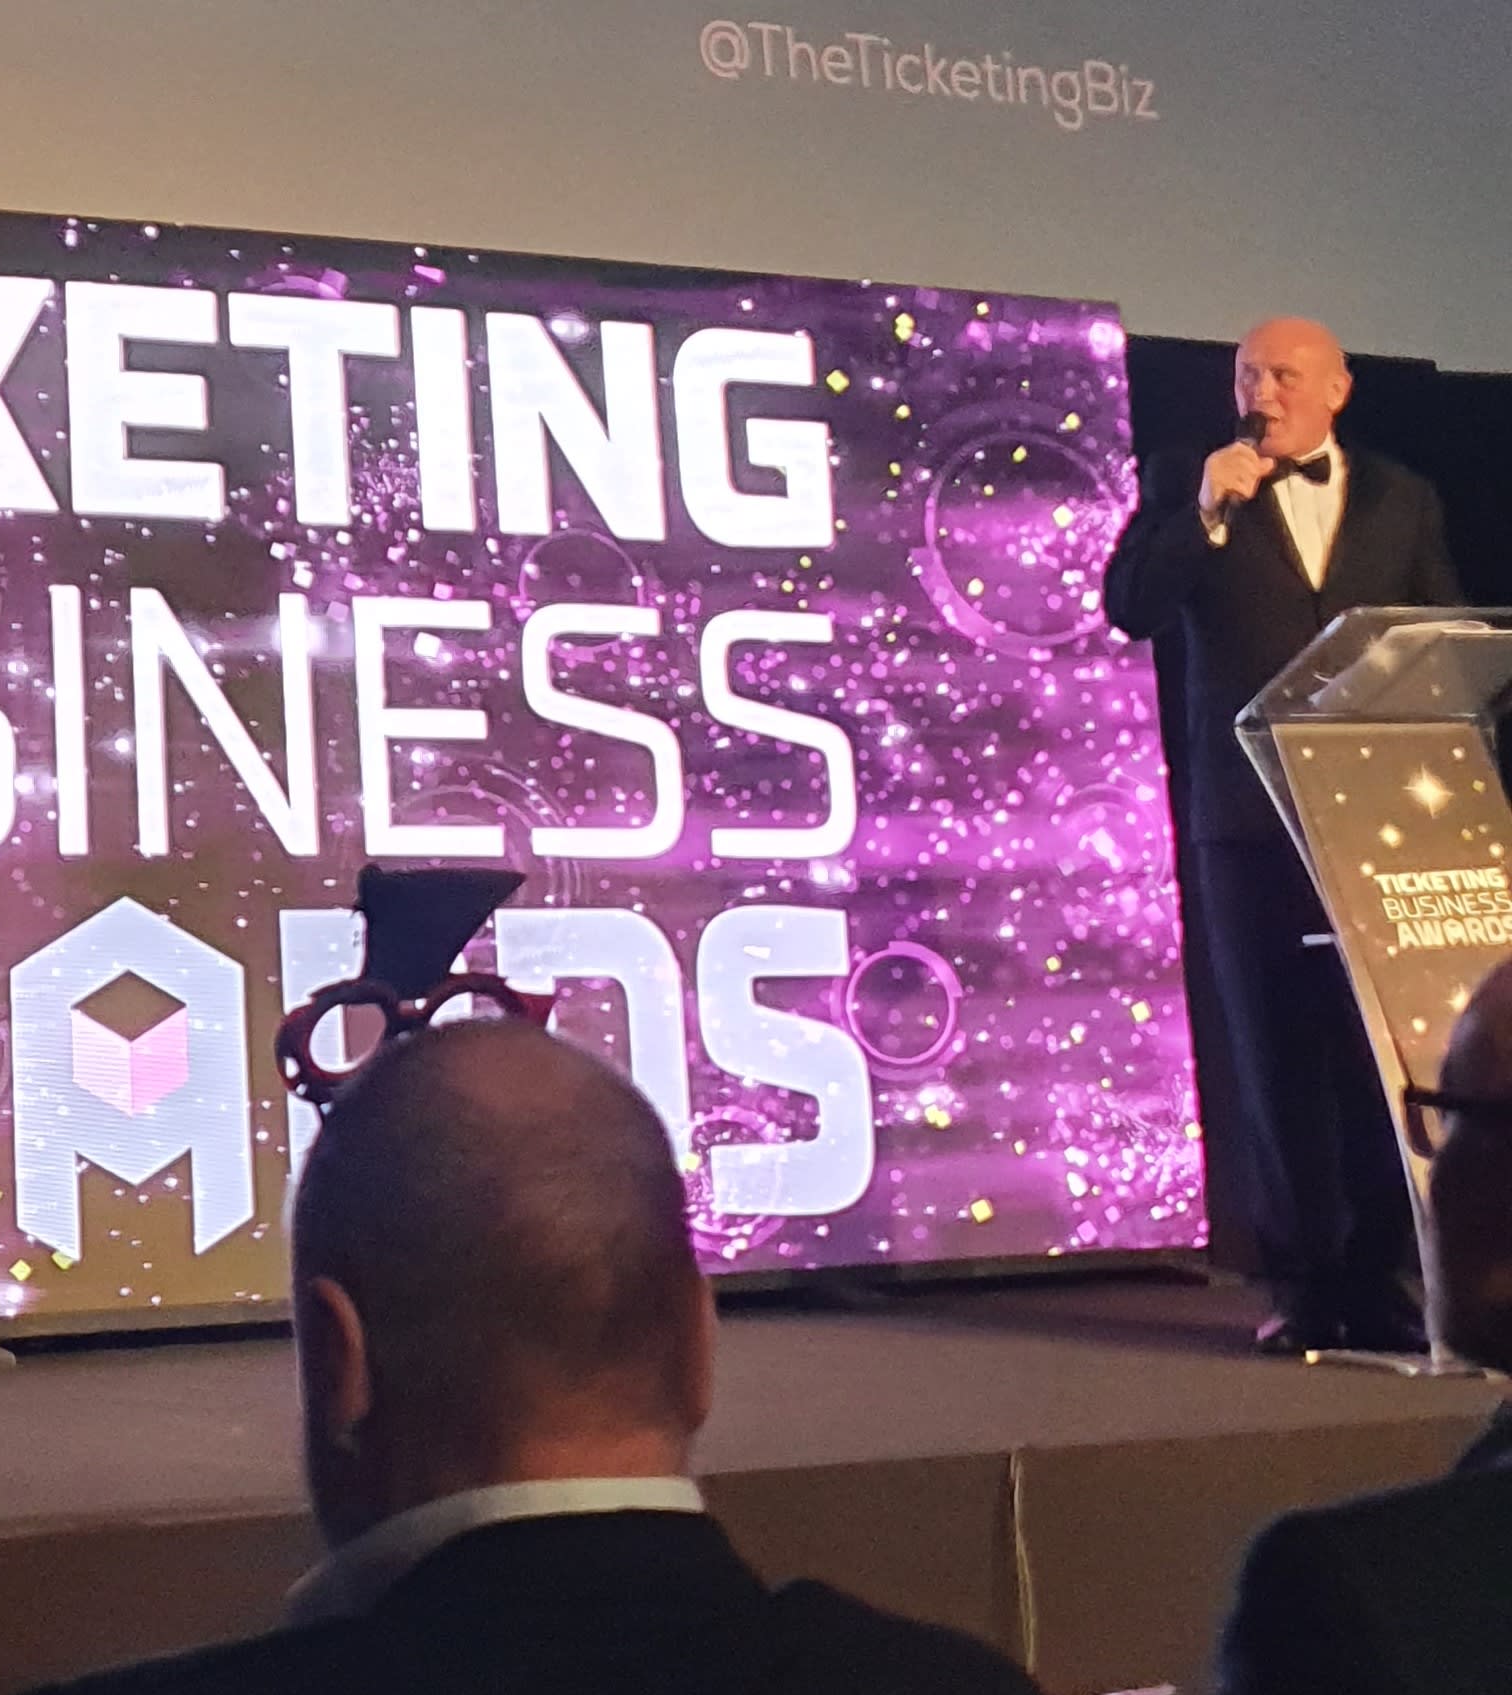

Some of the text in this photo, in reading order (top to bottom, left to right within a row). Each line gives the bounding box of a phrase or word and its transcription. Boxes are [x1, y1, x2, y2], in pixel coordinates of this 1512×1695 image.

[699, 19, 1159, 131] @TheTicketingBiz
[1373, 867, 1507, 894] TICKETING
[1382, 891, 1512, 920] BUSINESS
